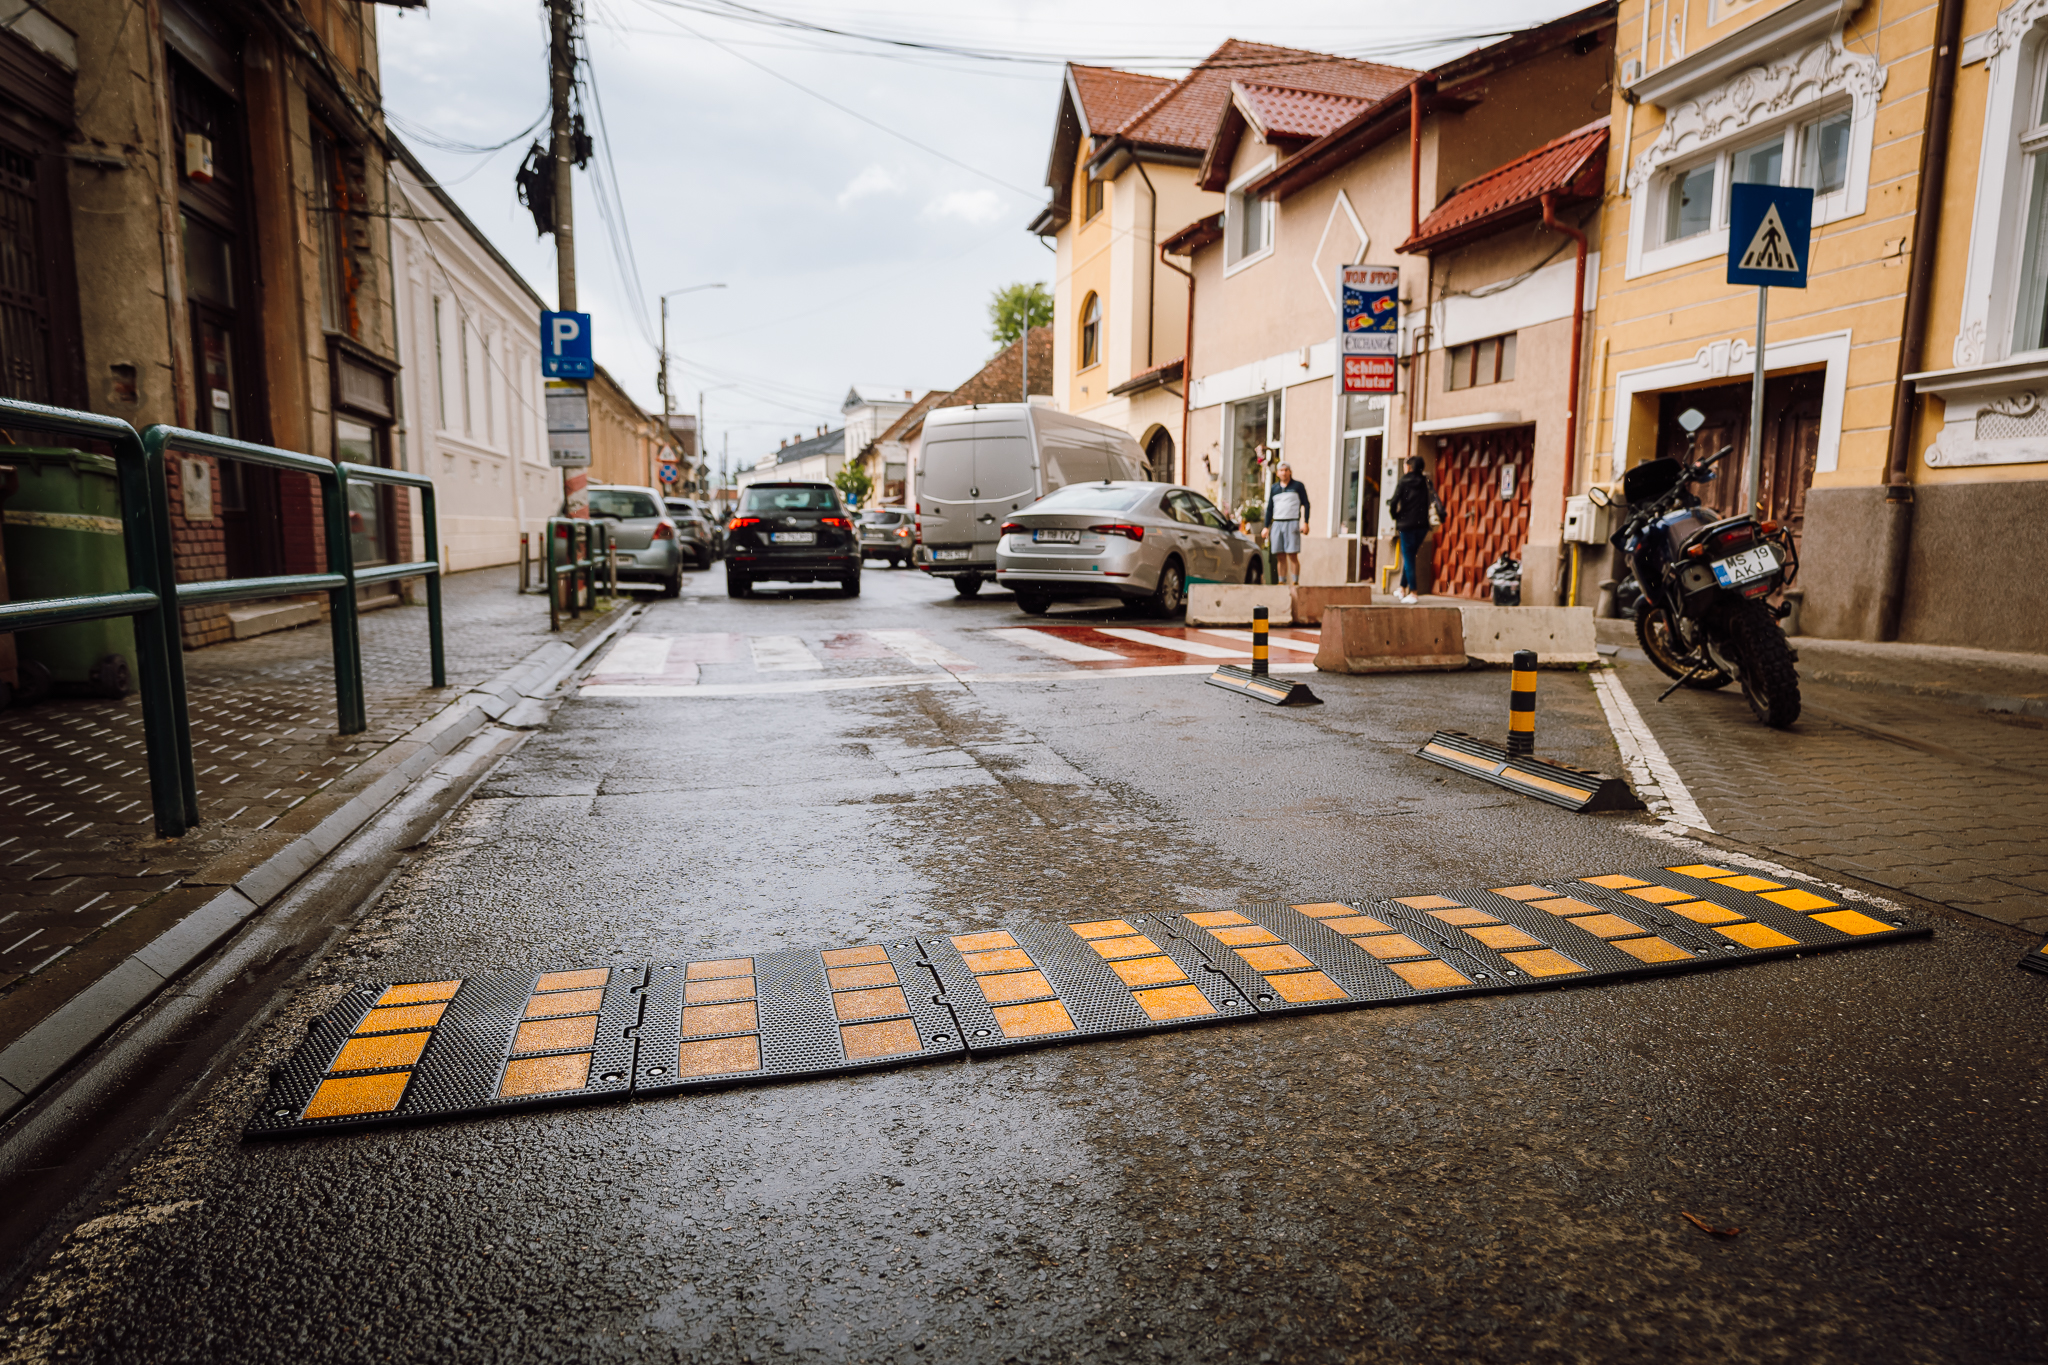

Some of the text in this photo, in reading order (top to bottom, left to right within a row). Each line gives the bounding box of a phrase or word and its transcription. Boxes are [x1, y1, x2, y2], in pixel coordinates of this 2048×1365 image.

[1344, 271, 1398, 285] NON STOP
[552, 317, 580, 356] P
[1346, 360, 1394, 375] Schimb
[1346, 375, 1393, 389] valutar
[1725, 547, 1769, 569] MS 19
[1735, 561, 1764, 580] AKJ
